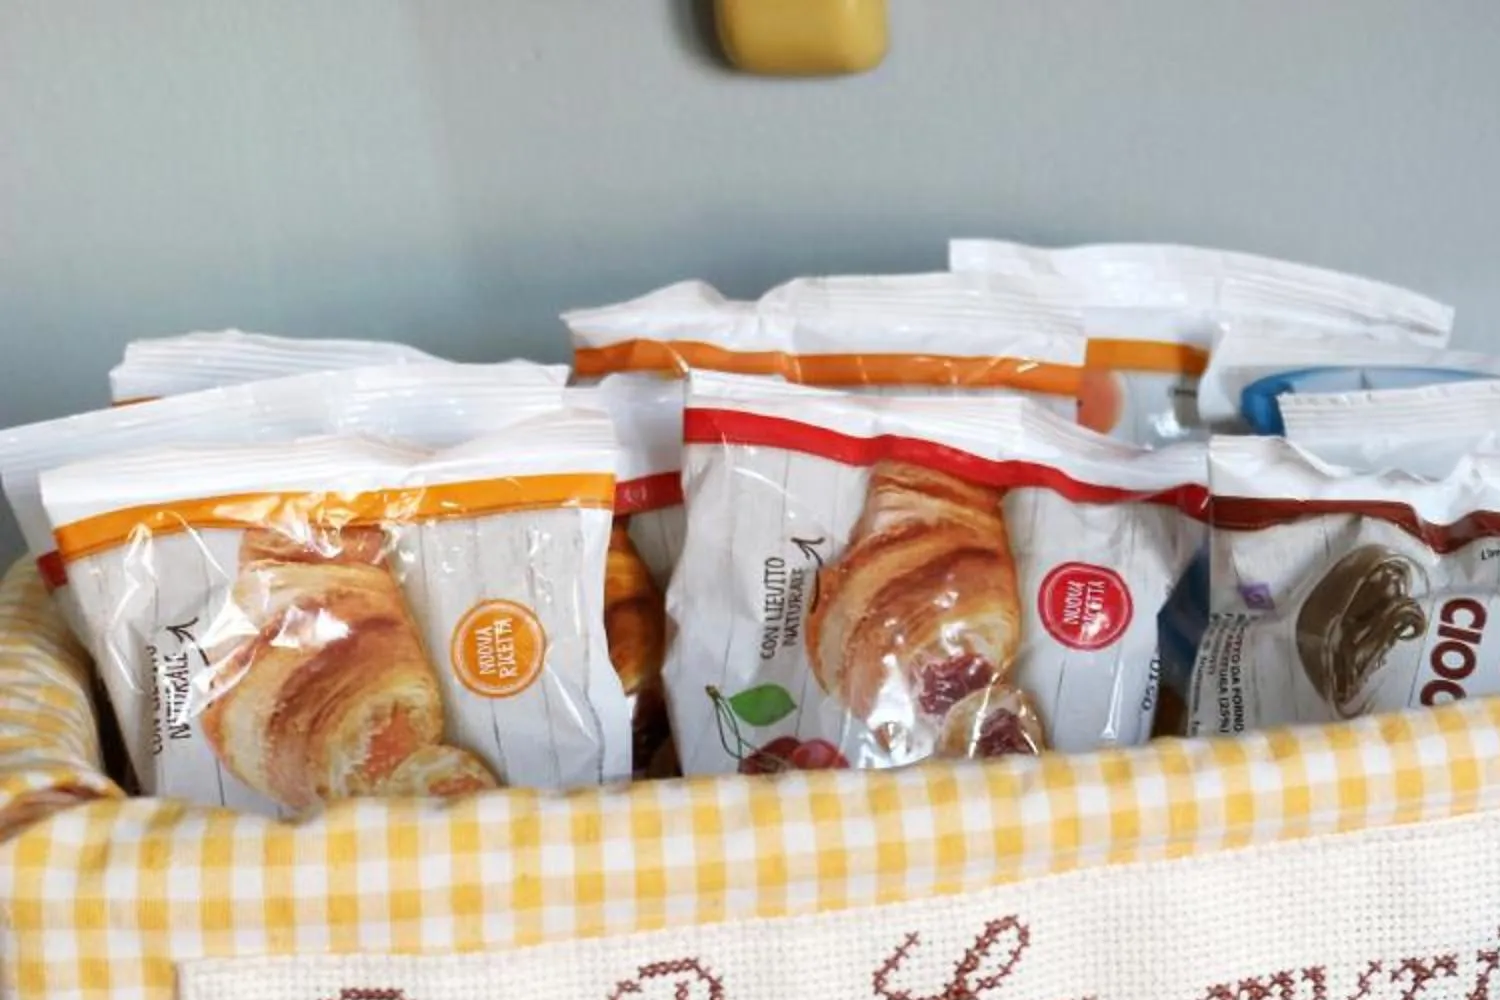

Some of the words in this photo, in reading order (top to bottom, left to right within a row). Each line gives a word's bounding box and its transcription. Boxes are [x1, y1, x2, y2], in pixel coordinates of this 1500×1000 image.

[764, 557, 786, 621] LIEVITO
[782, 568, 804, 647] NATURALE
[1063, 580, 1085, 625] NUOVA
[475, 626, 497, 675] NUOVA
[493, 617, 518, 679] RICETTA
[760, 626, 781, 659] CON
